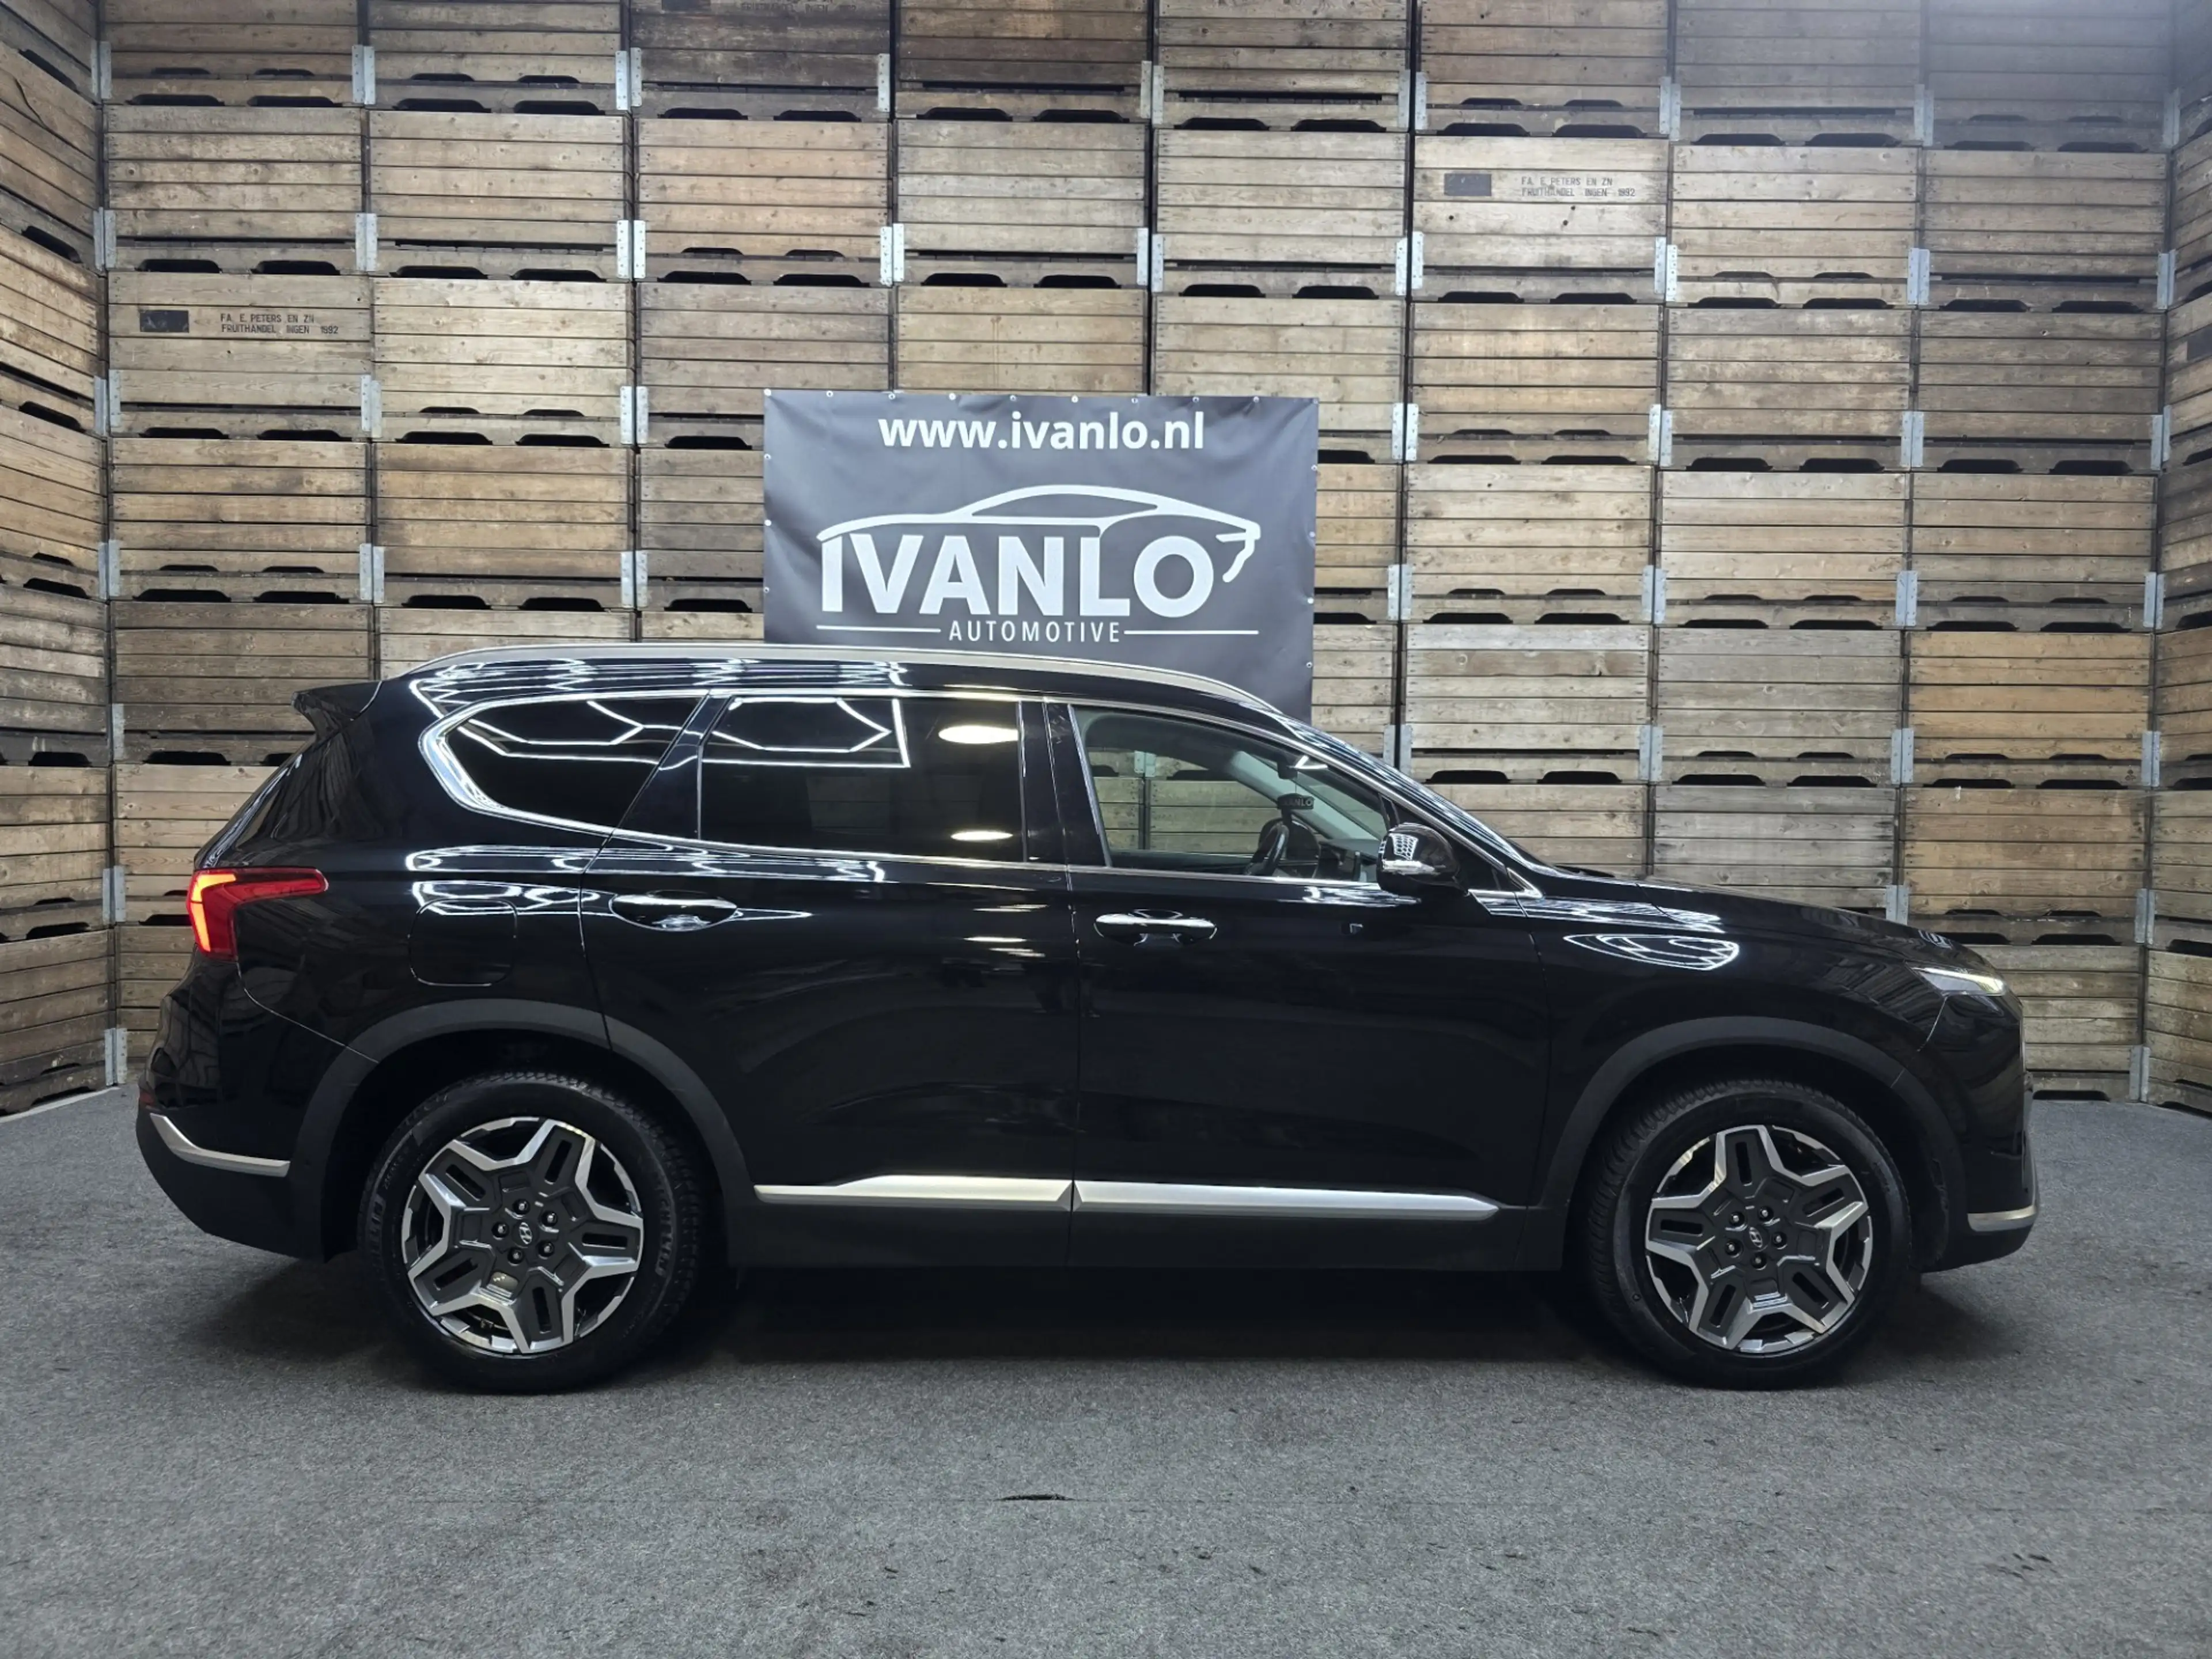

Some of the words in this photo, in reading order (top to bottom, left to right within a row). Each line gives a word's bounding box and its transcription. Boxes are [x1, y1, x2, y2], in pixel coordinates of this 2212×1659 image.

[1550, 177, 1581, 186] PETERS
[1586, 177, 1597, 185] EN
[1601, 177, 1612, 186] ZN
[250, 313, 282, 323] PETERS
[287, 314, 298, 323] EN
[221, 324, 276, 334] FRUITHANDEL
[286, 325, 310, 334] INGEN
[878, 411, 1204, 449] www.ivanlo.nl
[821, 533, 1214, 618] IVANLO
[949, 620, 1119, 642] AUTOMOTIVE
